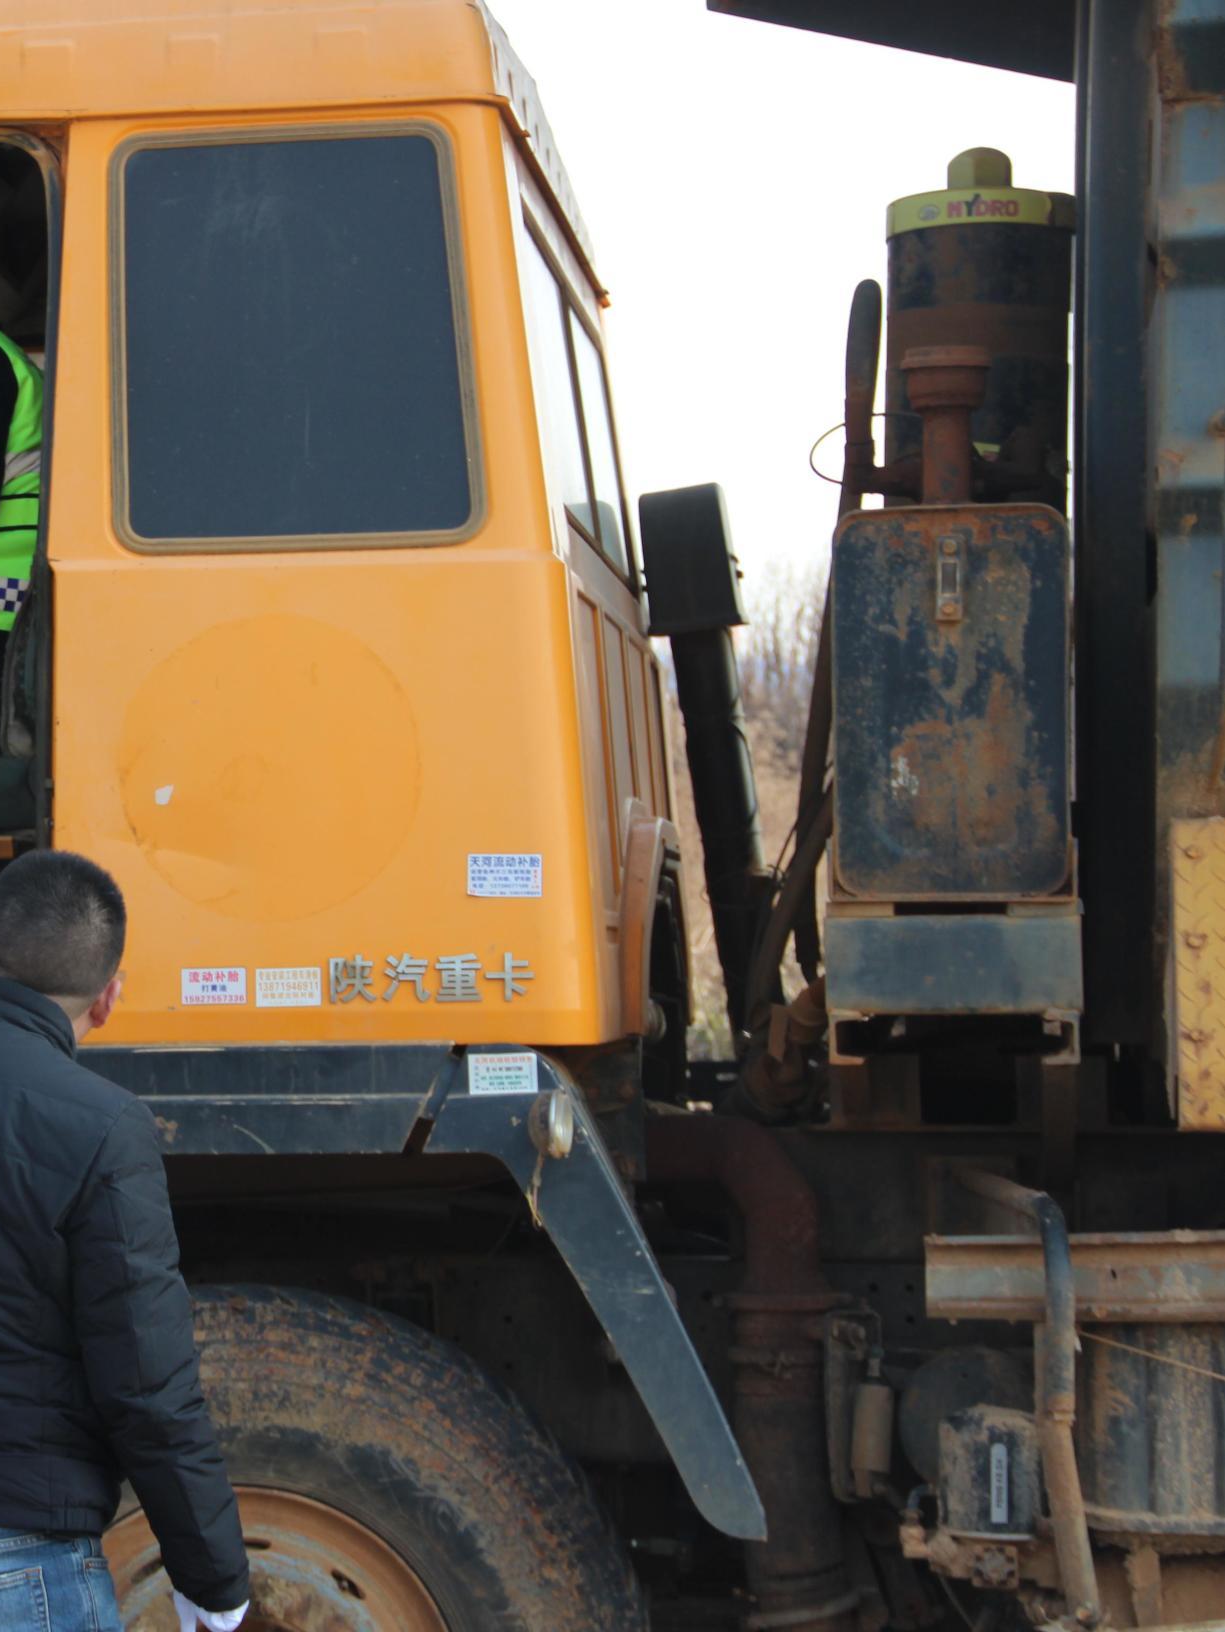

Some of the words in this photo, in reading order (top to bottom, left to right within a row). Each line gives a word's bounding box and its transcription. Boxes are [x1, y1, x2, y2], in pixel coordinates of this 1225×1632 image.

[947, 193, 1019, 218] HYDRO
[188, 970, 239, 983] 流动补胎
[328, 952, 536, 1004] 陕汽重卡
